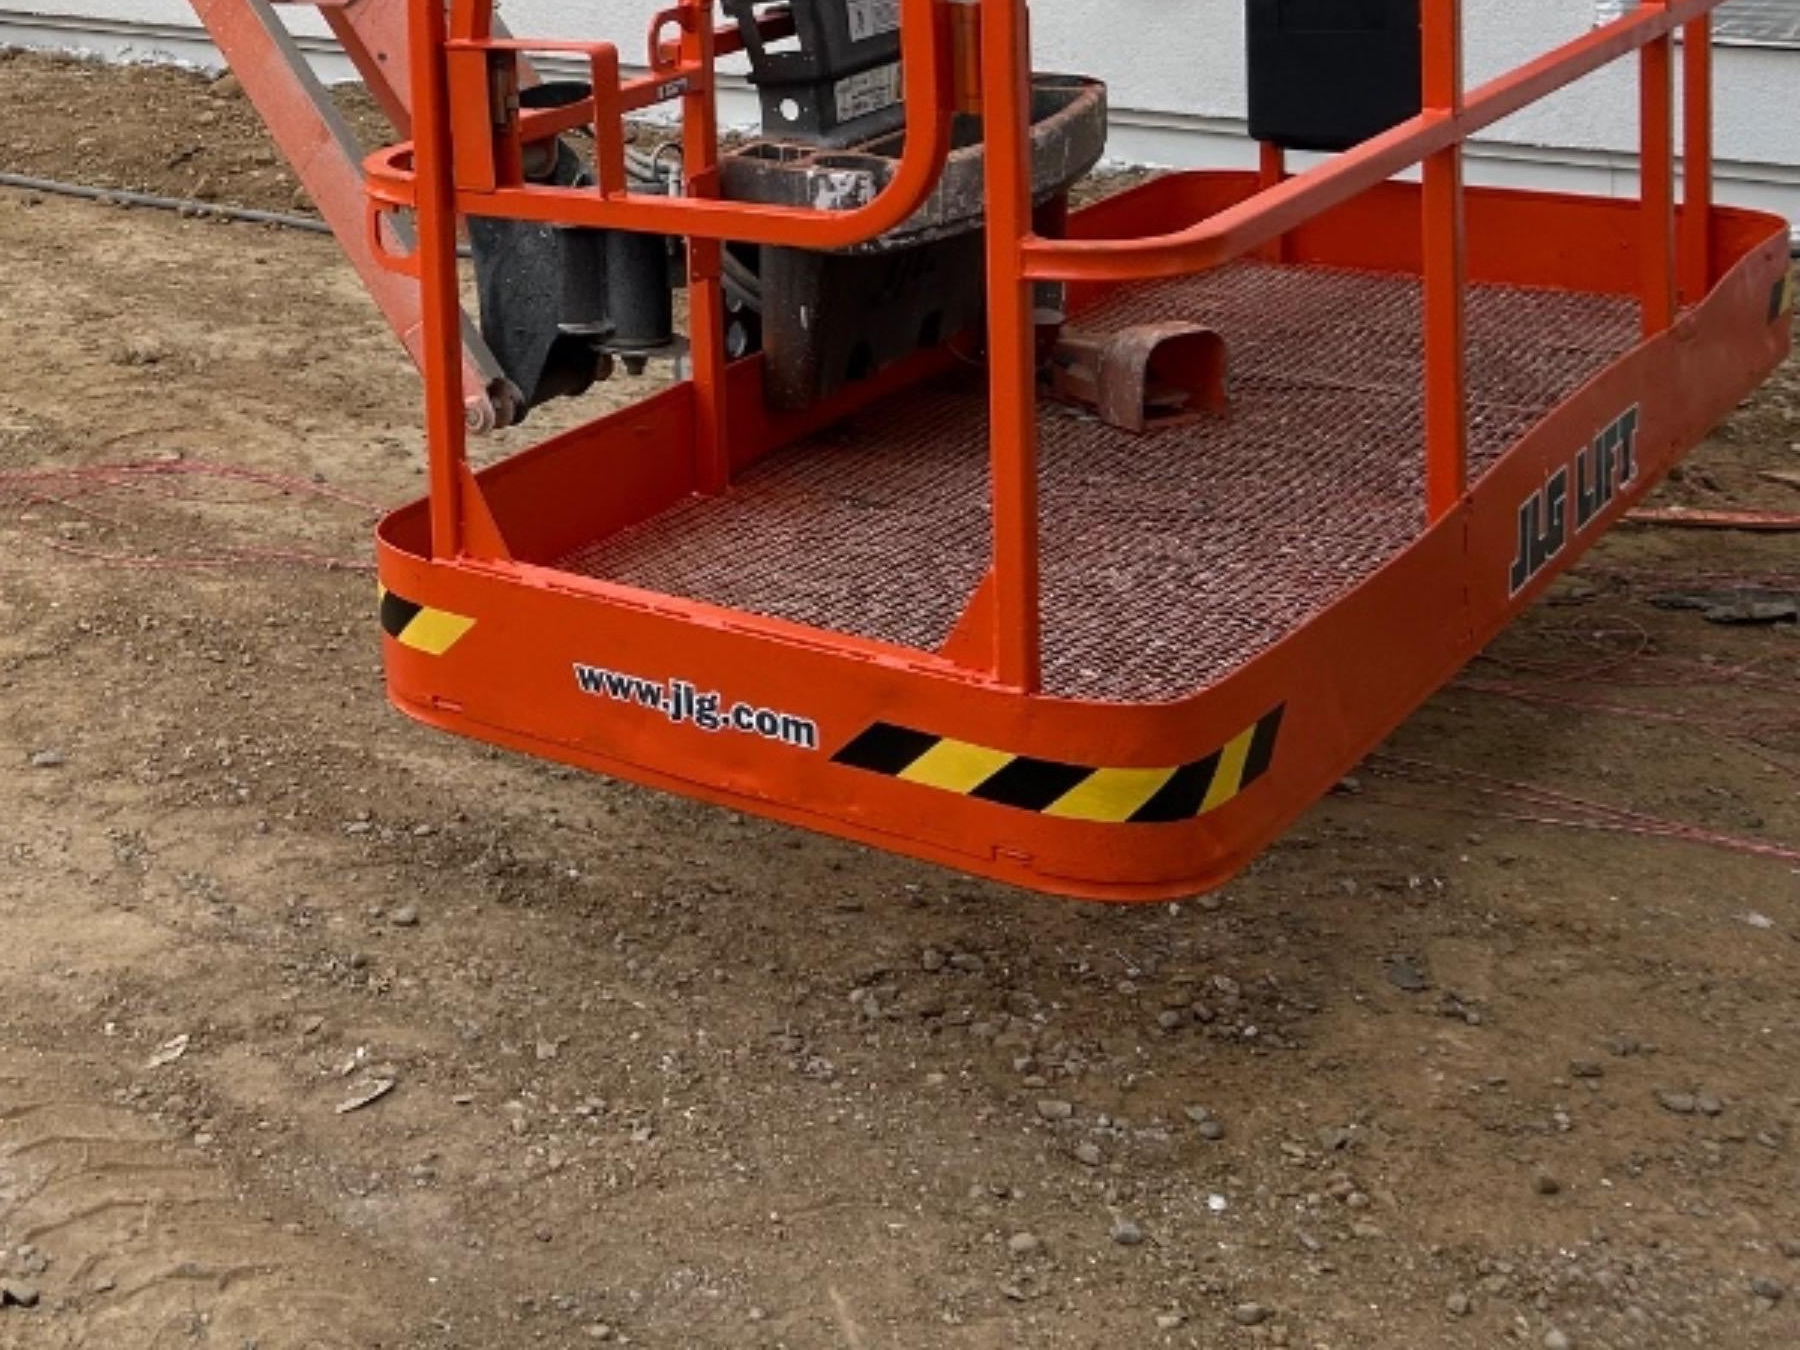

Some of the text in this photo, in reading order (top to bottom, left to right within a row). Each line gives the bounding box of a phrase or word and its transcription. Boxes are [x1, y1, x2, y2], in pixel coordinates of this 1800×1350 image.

[1509, 402, 1640, 600] JLG LIFT
[572, 662, 821, 750] www.jlg.com
